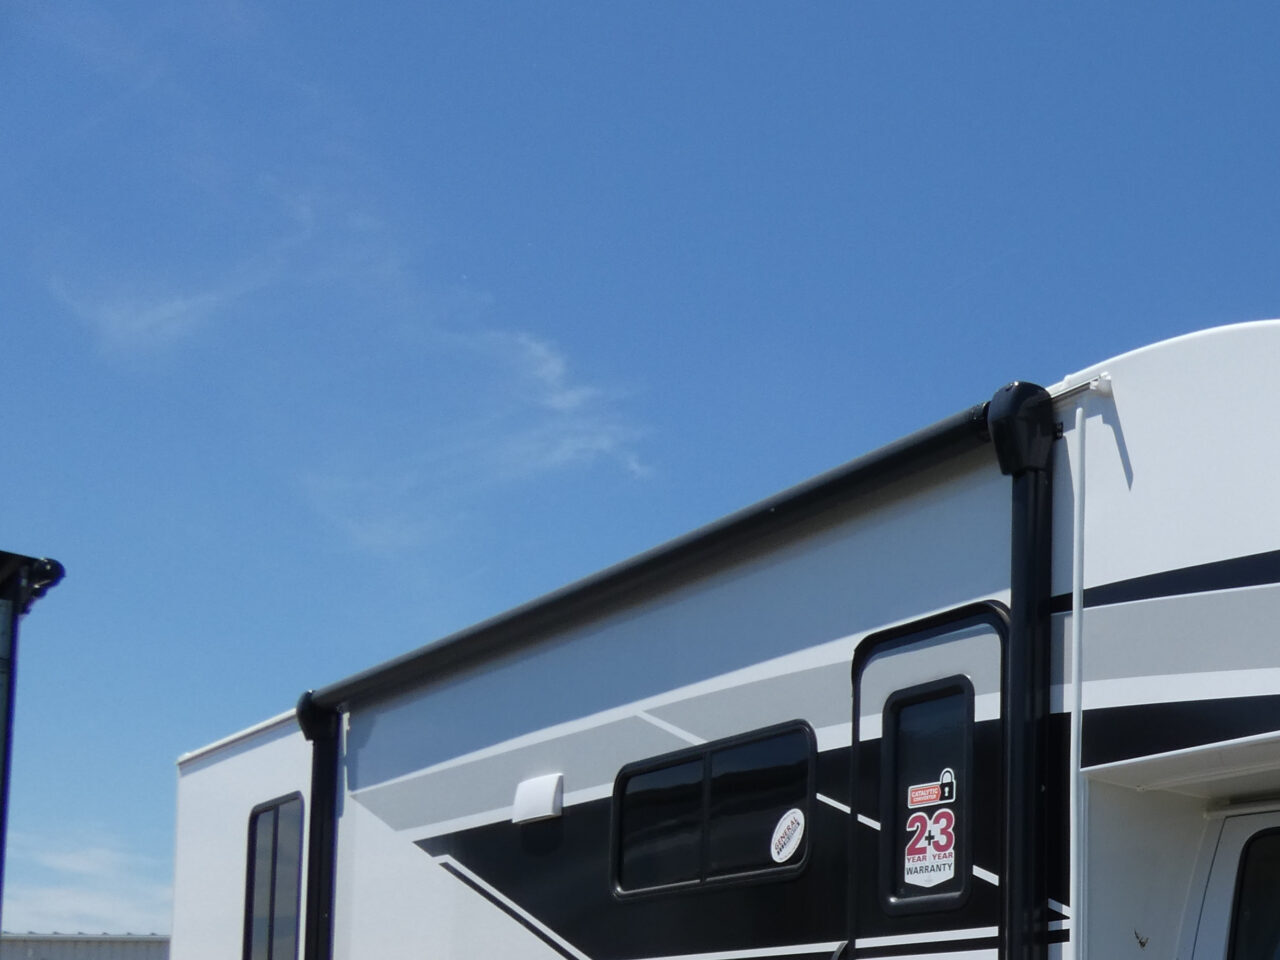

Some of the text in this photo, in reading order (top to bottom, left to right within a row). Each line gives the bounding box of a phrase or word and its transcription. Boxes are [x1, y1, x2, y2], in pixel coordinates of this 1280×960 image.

[911, 786, 939, 798] CATALYTIC
[906, 851, 953, 863] YEAR YEAR
[906, 862, 953, 876] WARRANTY
